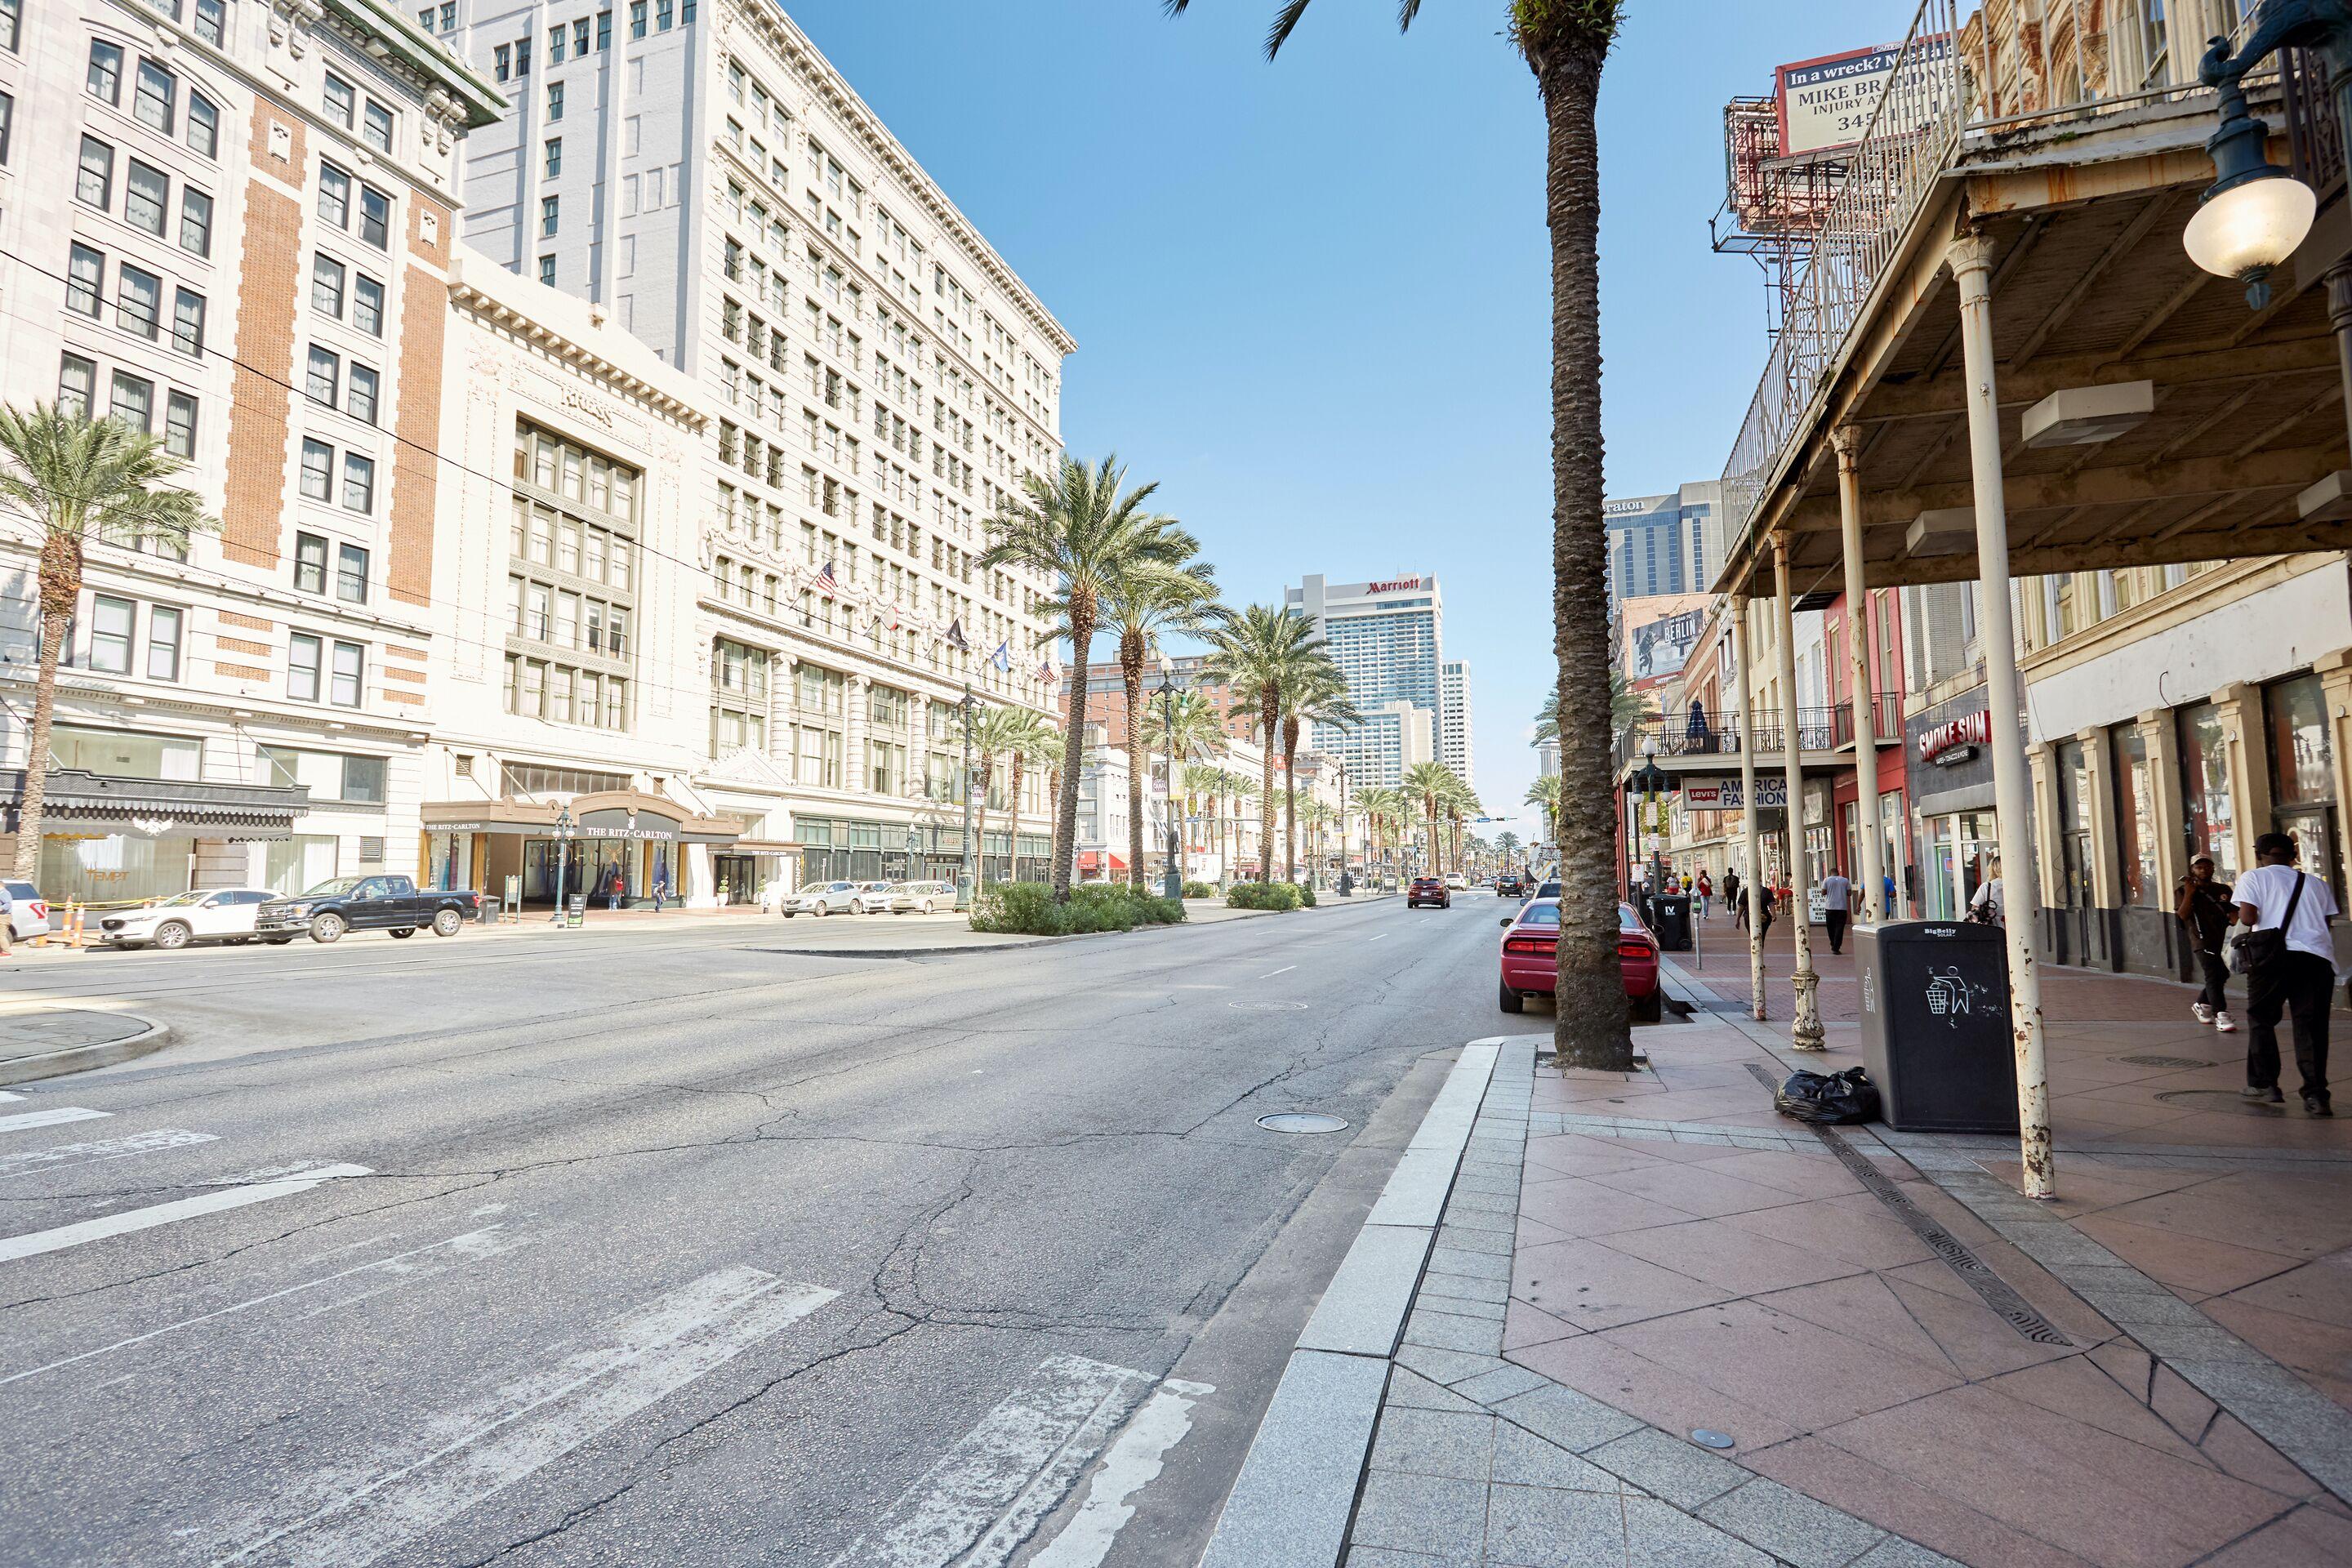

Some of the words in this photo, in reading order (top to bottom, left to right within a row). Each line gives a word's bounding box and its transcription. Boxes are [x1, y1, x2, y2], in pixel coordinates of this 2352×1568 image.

[1791, 73, 1803, 86] In
[1811, 70, 1820, 81] a
[1824, 57, 1881, 78] wreck?
[1798, 85, 1849, 107] MIKE
[1855, 65, 1955, 96] BRNDNE
[1813, 97, 1862, 115] INJURY
[1867, 81, 1954, 105] AORNEYS
[560, 385, 613, 428] KRESS
[1601, 500, 1646, 513] raton
[1365, 577, 1419, 595] Marriott
[1664, 618, 1696, 644] BERLIN
[1919, 721, 1954, 760] SMOKE
[1958, 710, 1986, 744] SUM
[1720, 778, 1788, 793] AMRICA
[1723, 791, 1787, 806] FAHION
[439, 822, 481, 831] RITZ-CARLTON
[586, 827, 607, 837] THE
[608, 827, 672, 840] RITZ-CARLTON
